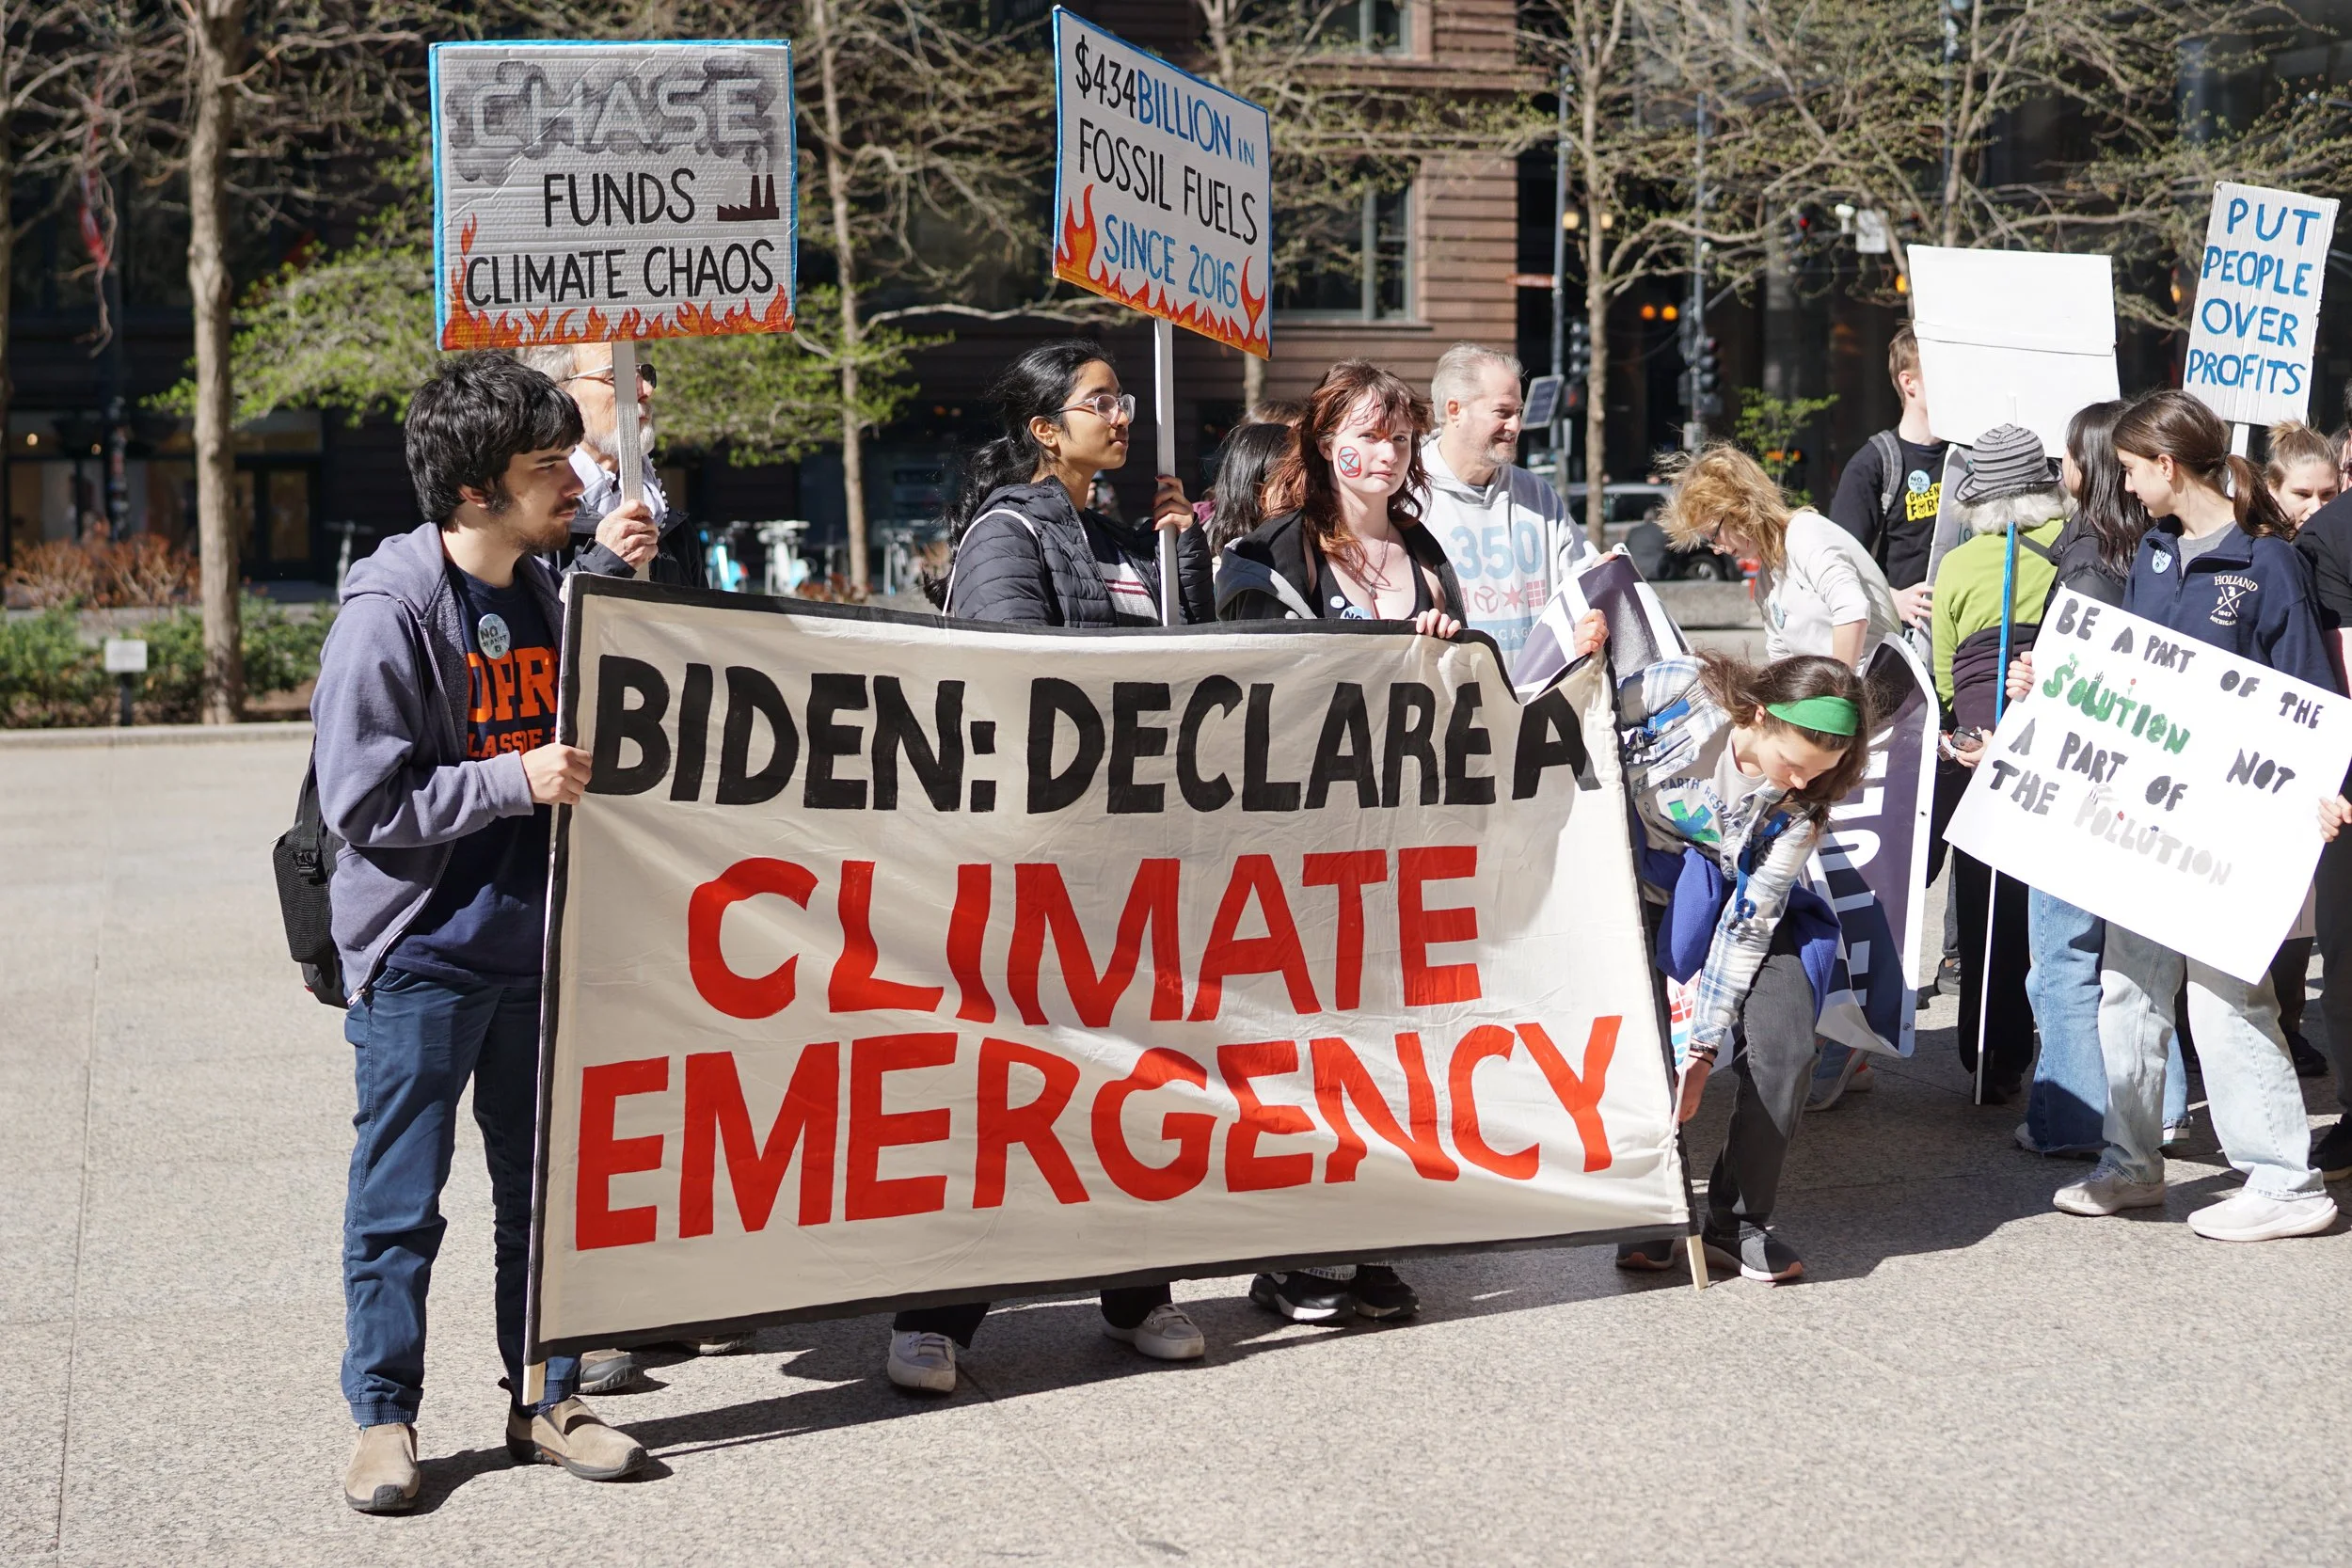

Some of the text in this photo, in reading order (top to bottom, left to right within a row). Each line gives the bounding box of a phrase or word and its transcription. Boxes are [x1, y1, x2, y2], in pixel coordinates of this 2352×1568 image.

[471, 78, 764, 147] CHASE
[1080, 119, 1257, 245] FOSSIL FUELS
[1239, 137, 1254, 167] IN
[544, 168, 695, 227] FUNDS
[2227, 198, 2321, 245] PUT
[467, 239, 774, 307] CLIMATE CHAOS
[1104, 214, 1238, 309] SINCE 2016
[2202, 245, 2312, 296] PEOPLE
[2202, 298, 2298, 347] OVER
[2187, 349, 2306, 395] PROFITS
[1451, 520, 1543, 579] 350
[2214, 575, 2258, 592] HOLLAND
[480, 625, 499, 641] NO
[2209, 614, 2236, 626] MICHIGAN
[2056, 598, 2325, 729] BE A PART OF THE
[591, 655, 1603, 815] BIDEN: DECLARE A
[2042, 663, 2296, 794] SOLUTION NOT
[1660, 777, 1701, 792] EARTH
[2009, 718, 2188, 812] A PART OF
[1990, 760, 2233, 885] THE POLLUTION
[688, 846, 1483, 1028] CLIMATE
[576, 1016, 1623, 1251] EMERGENCY
